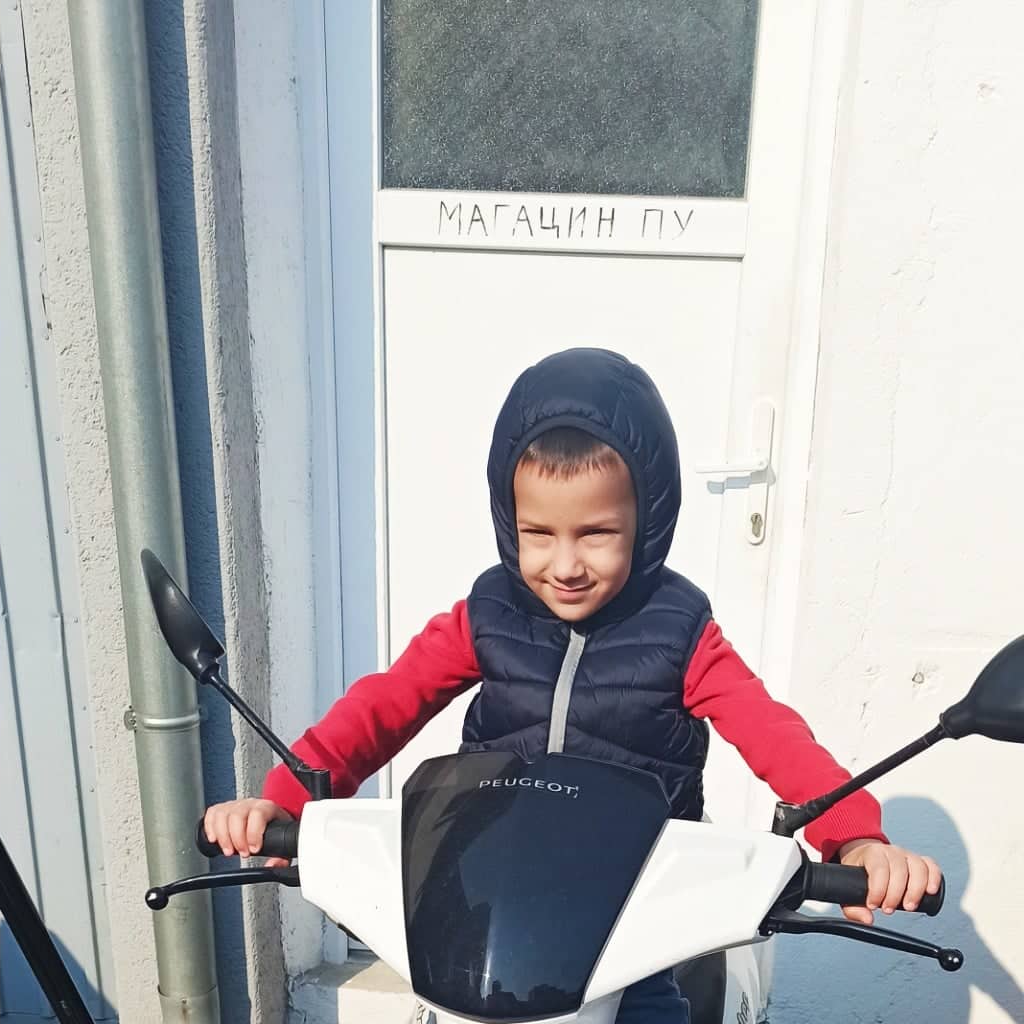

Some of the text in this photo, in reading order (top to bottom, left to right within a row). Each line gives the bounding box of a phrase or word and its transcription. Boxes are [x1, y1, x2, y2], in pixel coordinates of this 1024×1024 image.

[438, 200, 694, 240] МАГАЦИН ПУ
[479, 777, 577, 795] PEUGEOT
